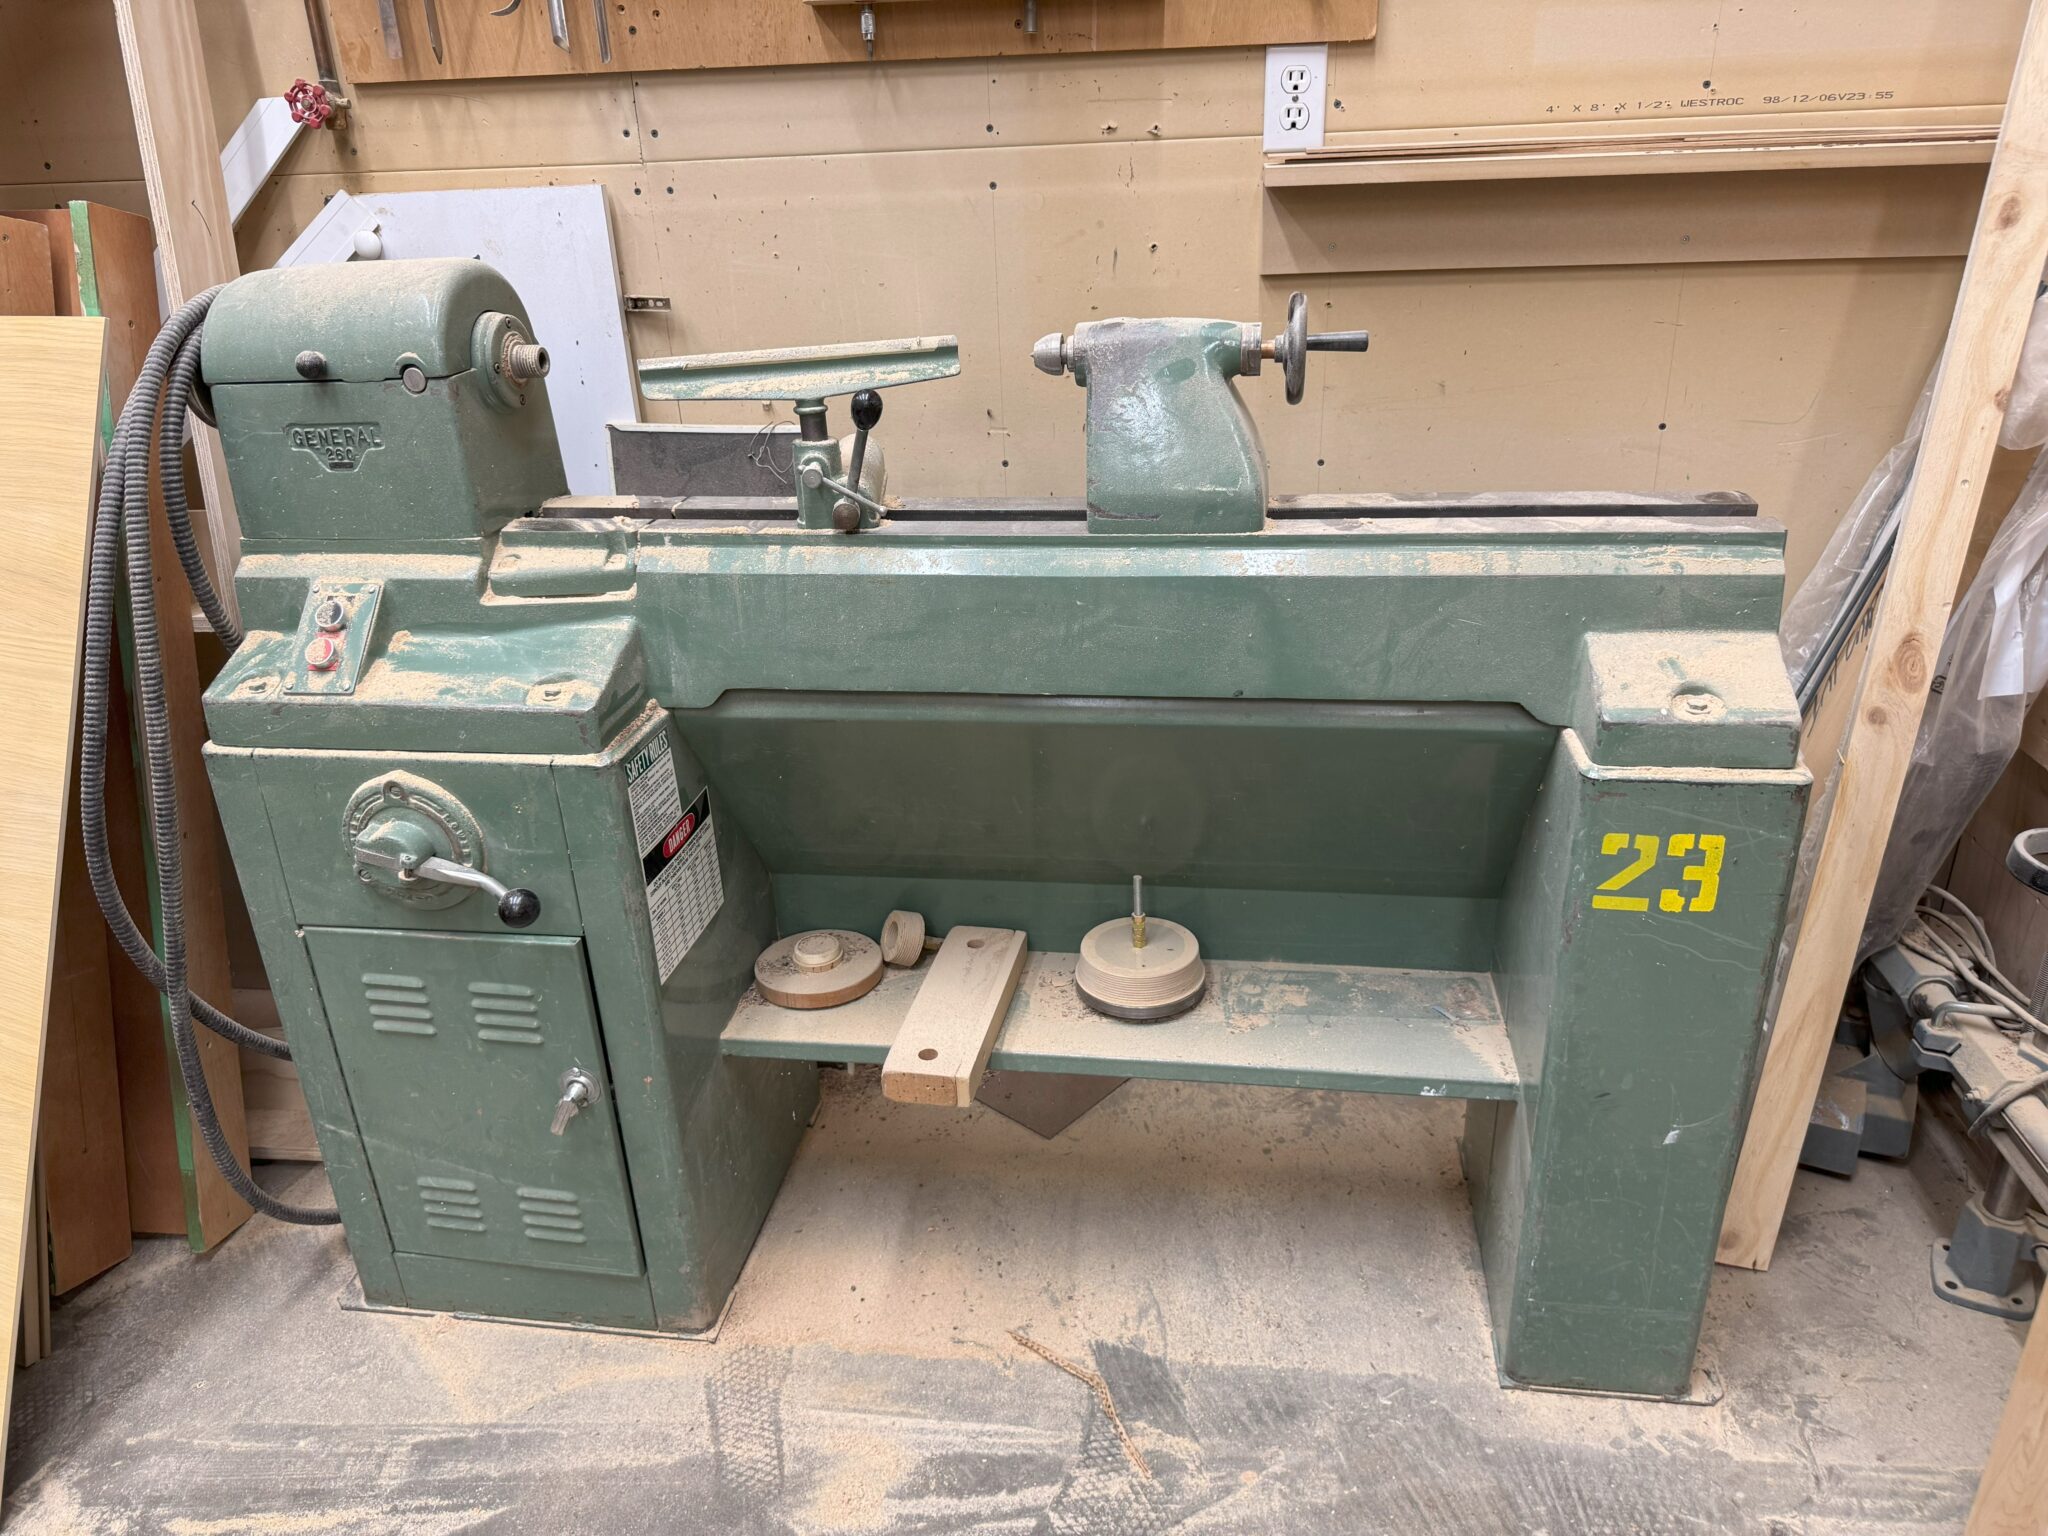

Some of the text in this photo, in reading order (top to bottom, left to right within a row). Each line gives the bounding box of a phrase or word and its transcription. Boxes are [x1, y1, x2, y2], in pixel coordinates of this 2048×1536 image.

[1545, 104, 1560, 114] 4'
[1572, 104, 1582, 113] X
[1590, 103, 1606, 112] 8'
[1617, 102, 1628, 111] X
[1680, 97, 1744, 108] WESTROC
[291, 426, 382, 449] GENERAL
[626, 729, 669, 784] SAFETY RULES
[667, 818, 692, 853] DANGER
[1591, 832, 1726, 913] 23
